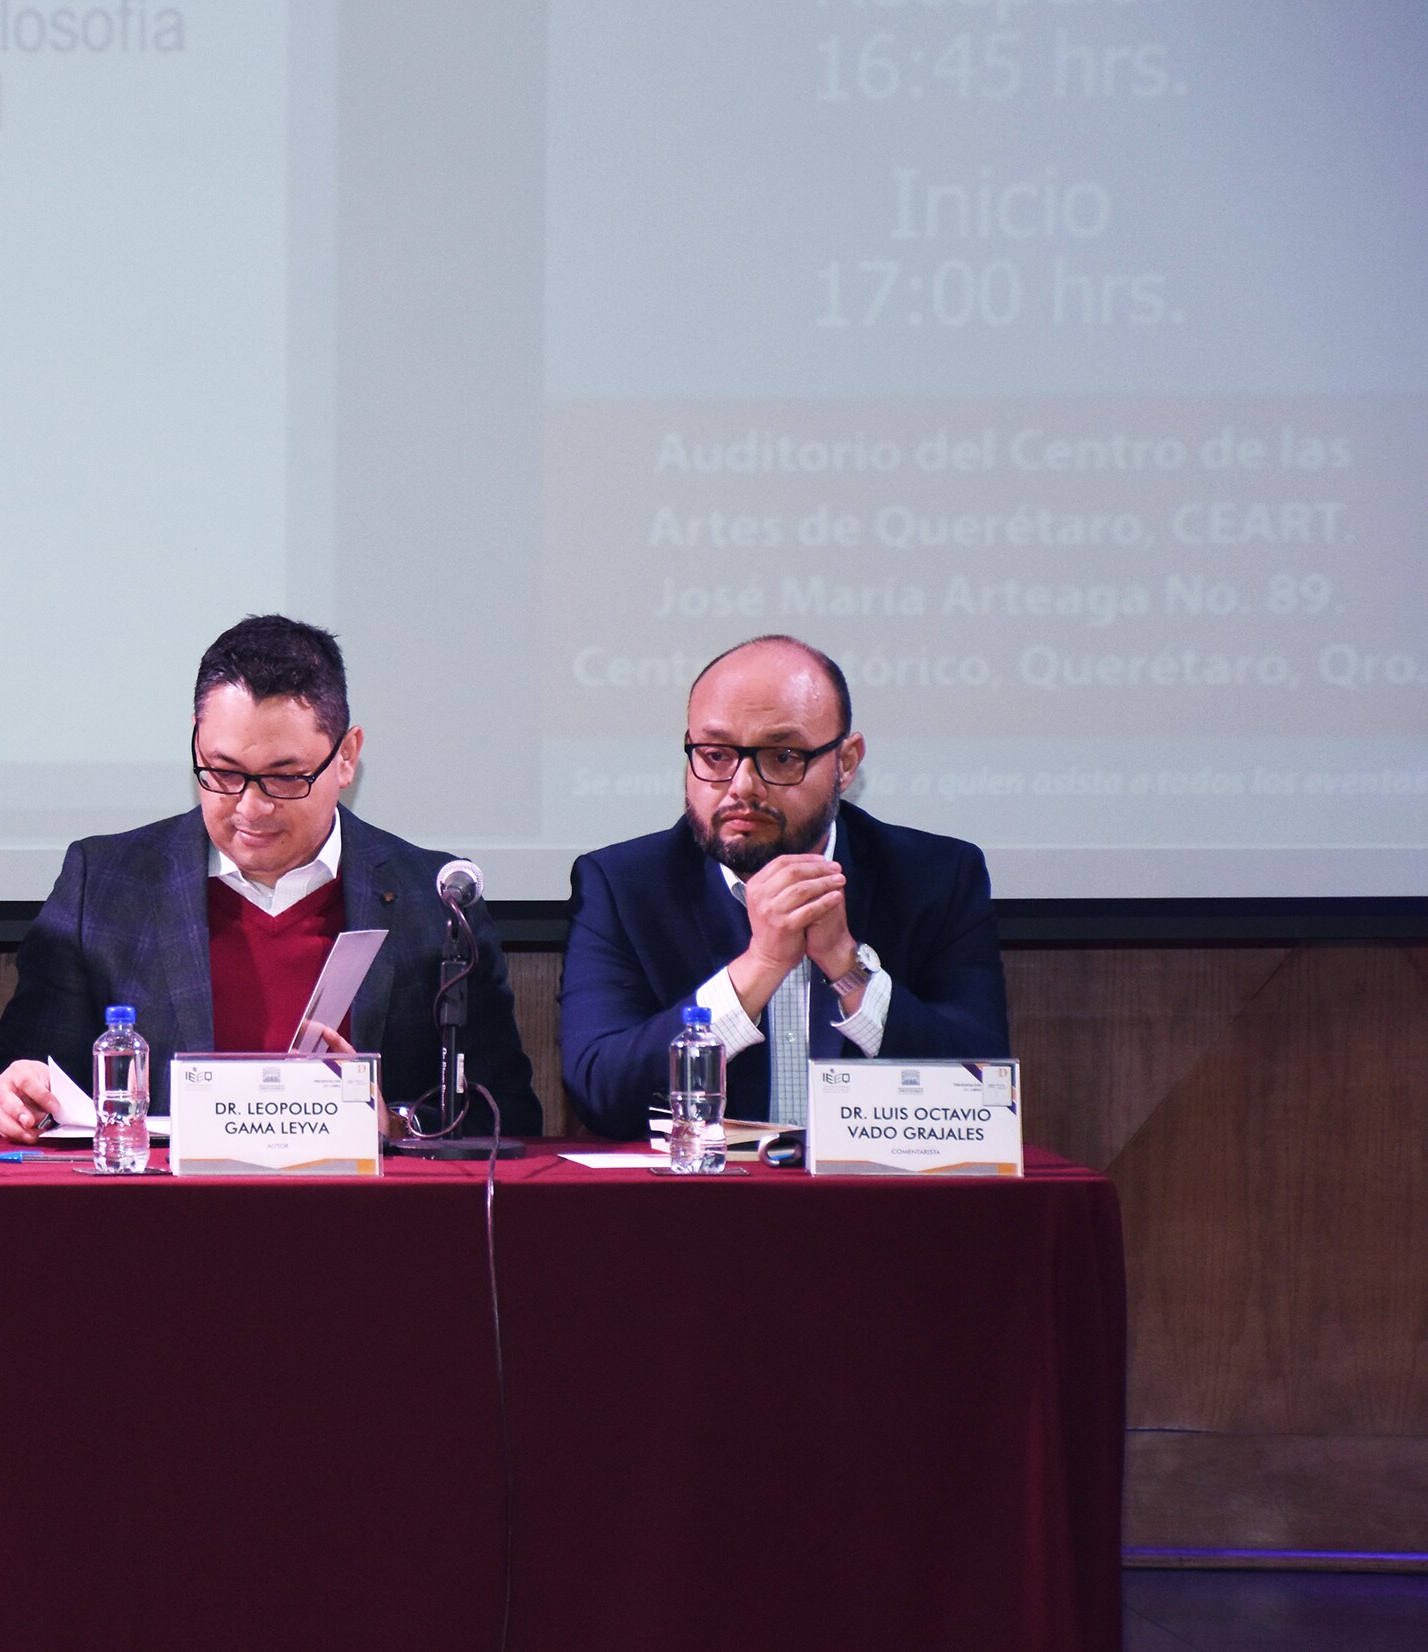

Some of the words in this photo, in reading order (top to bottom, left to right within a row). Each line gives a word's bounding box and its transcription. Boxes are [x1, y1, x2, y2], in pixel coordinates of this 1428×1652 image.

[816, 30, 1023, 101] 16:45
[1053, 27, 1188, 99] hrs.
[891, 166, 1112, 240] Inicio
[816, 259, 1023, 328] 17:00
[1052, 256, 1186, 325] hrs.
[653, 429, 902, 473] Auditorio
[914, 427, 996, 472] del
[1009, 427, 1187, 471] Centro
[1200, 426, 1268, 470] de
[1278, 424, 1354, 470] las
[646, 506, 784, 548] Artes
[798, 504, 862, 548] de
[876, 504, 1155, 551] Querétaro,
[1172, 501, 1355, 545] CEART.
[655, 576, 766, 618] José
[781, 575, 926, 616] María
[942, 575, 1152, 628] Arteaga
[1166, 574, 1251, 616] No.
[1267, 572, 1347, 616] 89.
[1018, 644, 1304, 692] Querétaro,
[215, 1102, 241, 1115] DR.
[248, 1102, 338, 1115] LEOPOLDO
[225, 1122, 275, 1135] GAMA
[281, 1122, 330, 1135] LEYVA
[840, 1106, 867, 1120] DR.
[873, 1107, 908, 1120] LUIS
[914, 1108, 991, 1122] OCTAVIO
[847, 1126, 897, 1139] VADO
[904, 1127, 984, 1141] GRAJALES
